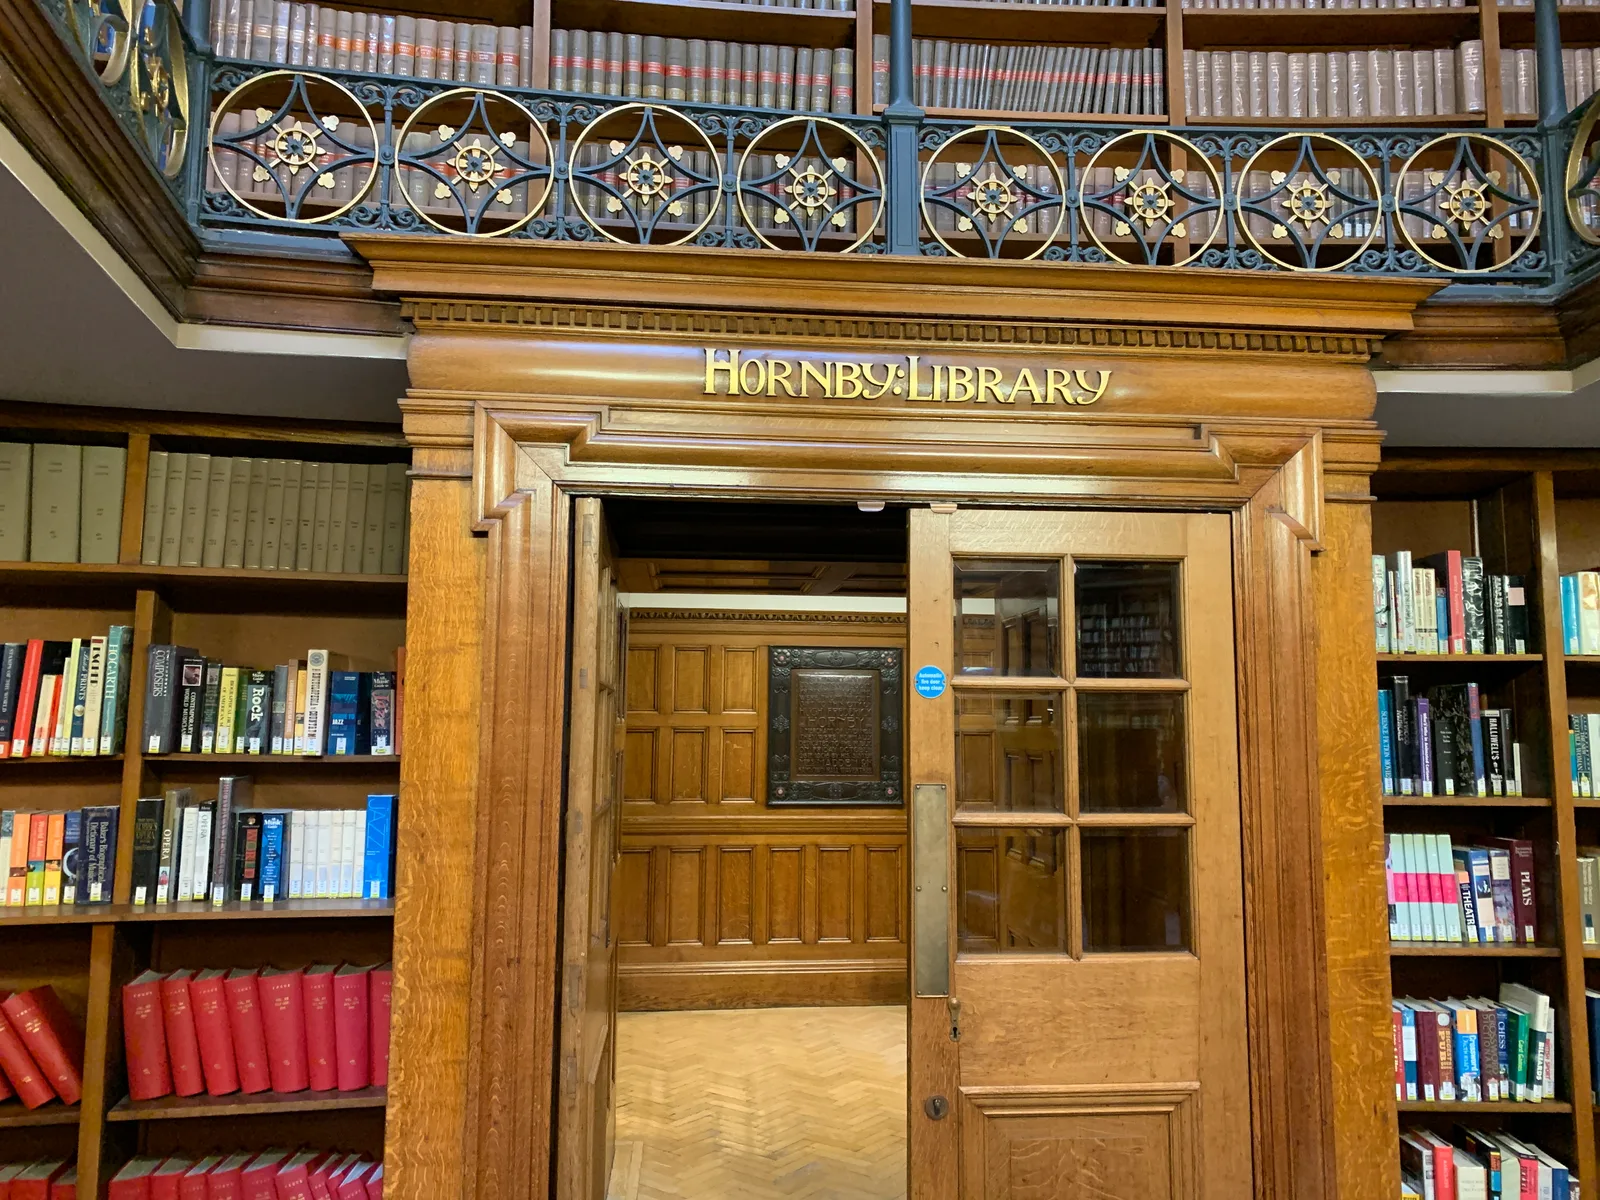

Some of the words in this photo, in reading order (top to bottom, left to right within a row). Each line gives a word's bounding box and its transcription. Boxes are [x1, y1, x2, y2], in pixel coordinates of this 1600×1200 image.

[1495, 608, 1504, 634] BLACK
[78, 676, 87, 701] PRINTS
[105, 644, 119, 700] HOGARTH
[152, 650, 167, 697] COMPOSERS
[187, 691, 197, 735] CONTEMPORARY
[219, 695, 227, 721] AMERICAN
[250, 687, 265, 722] Rock
[180, 708, 188, 738] MUSICIAN
[807, 716, 865, 728] HORNBY
[1381, 711, 1389, 735] SCIENCE
[1396, 709, 1404, 742] MUSICALS
[1403, 706, 1411, 746] HOLLYWOOD
[1573, 716, 1581, 746] QUOTABLE
[1383, 735, 1391, 758] FICTION
[1489, 717, 1500, 761] HALLIWELL'S
[1576, 747, 1584, 771] WOMAN
[88, 822, 99, 855] Dictionary
[100, 821, 109, 845] Baker's
[200, 814, 208, 839] OPERA
[367, 799, 387, 849] JAZZ
[161, 829, 172, 860] OPERA
[97, 844, 108, 882] Biographical
[1520, 871, 1533, 906] PLAYS
[1461, 890, 1476, 925] THEATR
[1438, 1030, 1447, 1062] PUB
[1482, 1013, 1491, 1076] DICTIONARY
[1488, 1013, 1498, 1075] CROSSWORD
[1498, 1021, 1507, 1050] CHESS
[1462, 1036, 1470, 1071] Dictionary
[1469, 1034, 1479, 1072] Crossword
[1536, 1041, 1545, 1081] BILLIARDS
